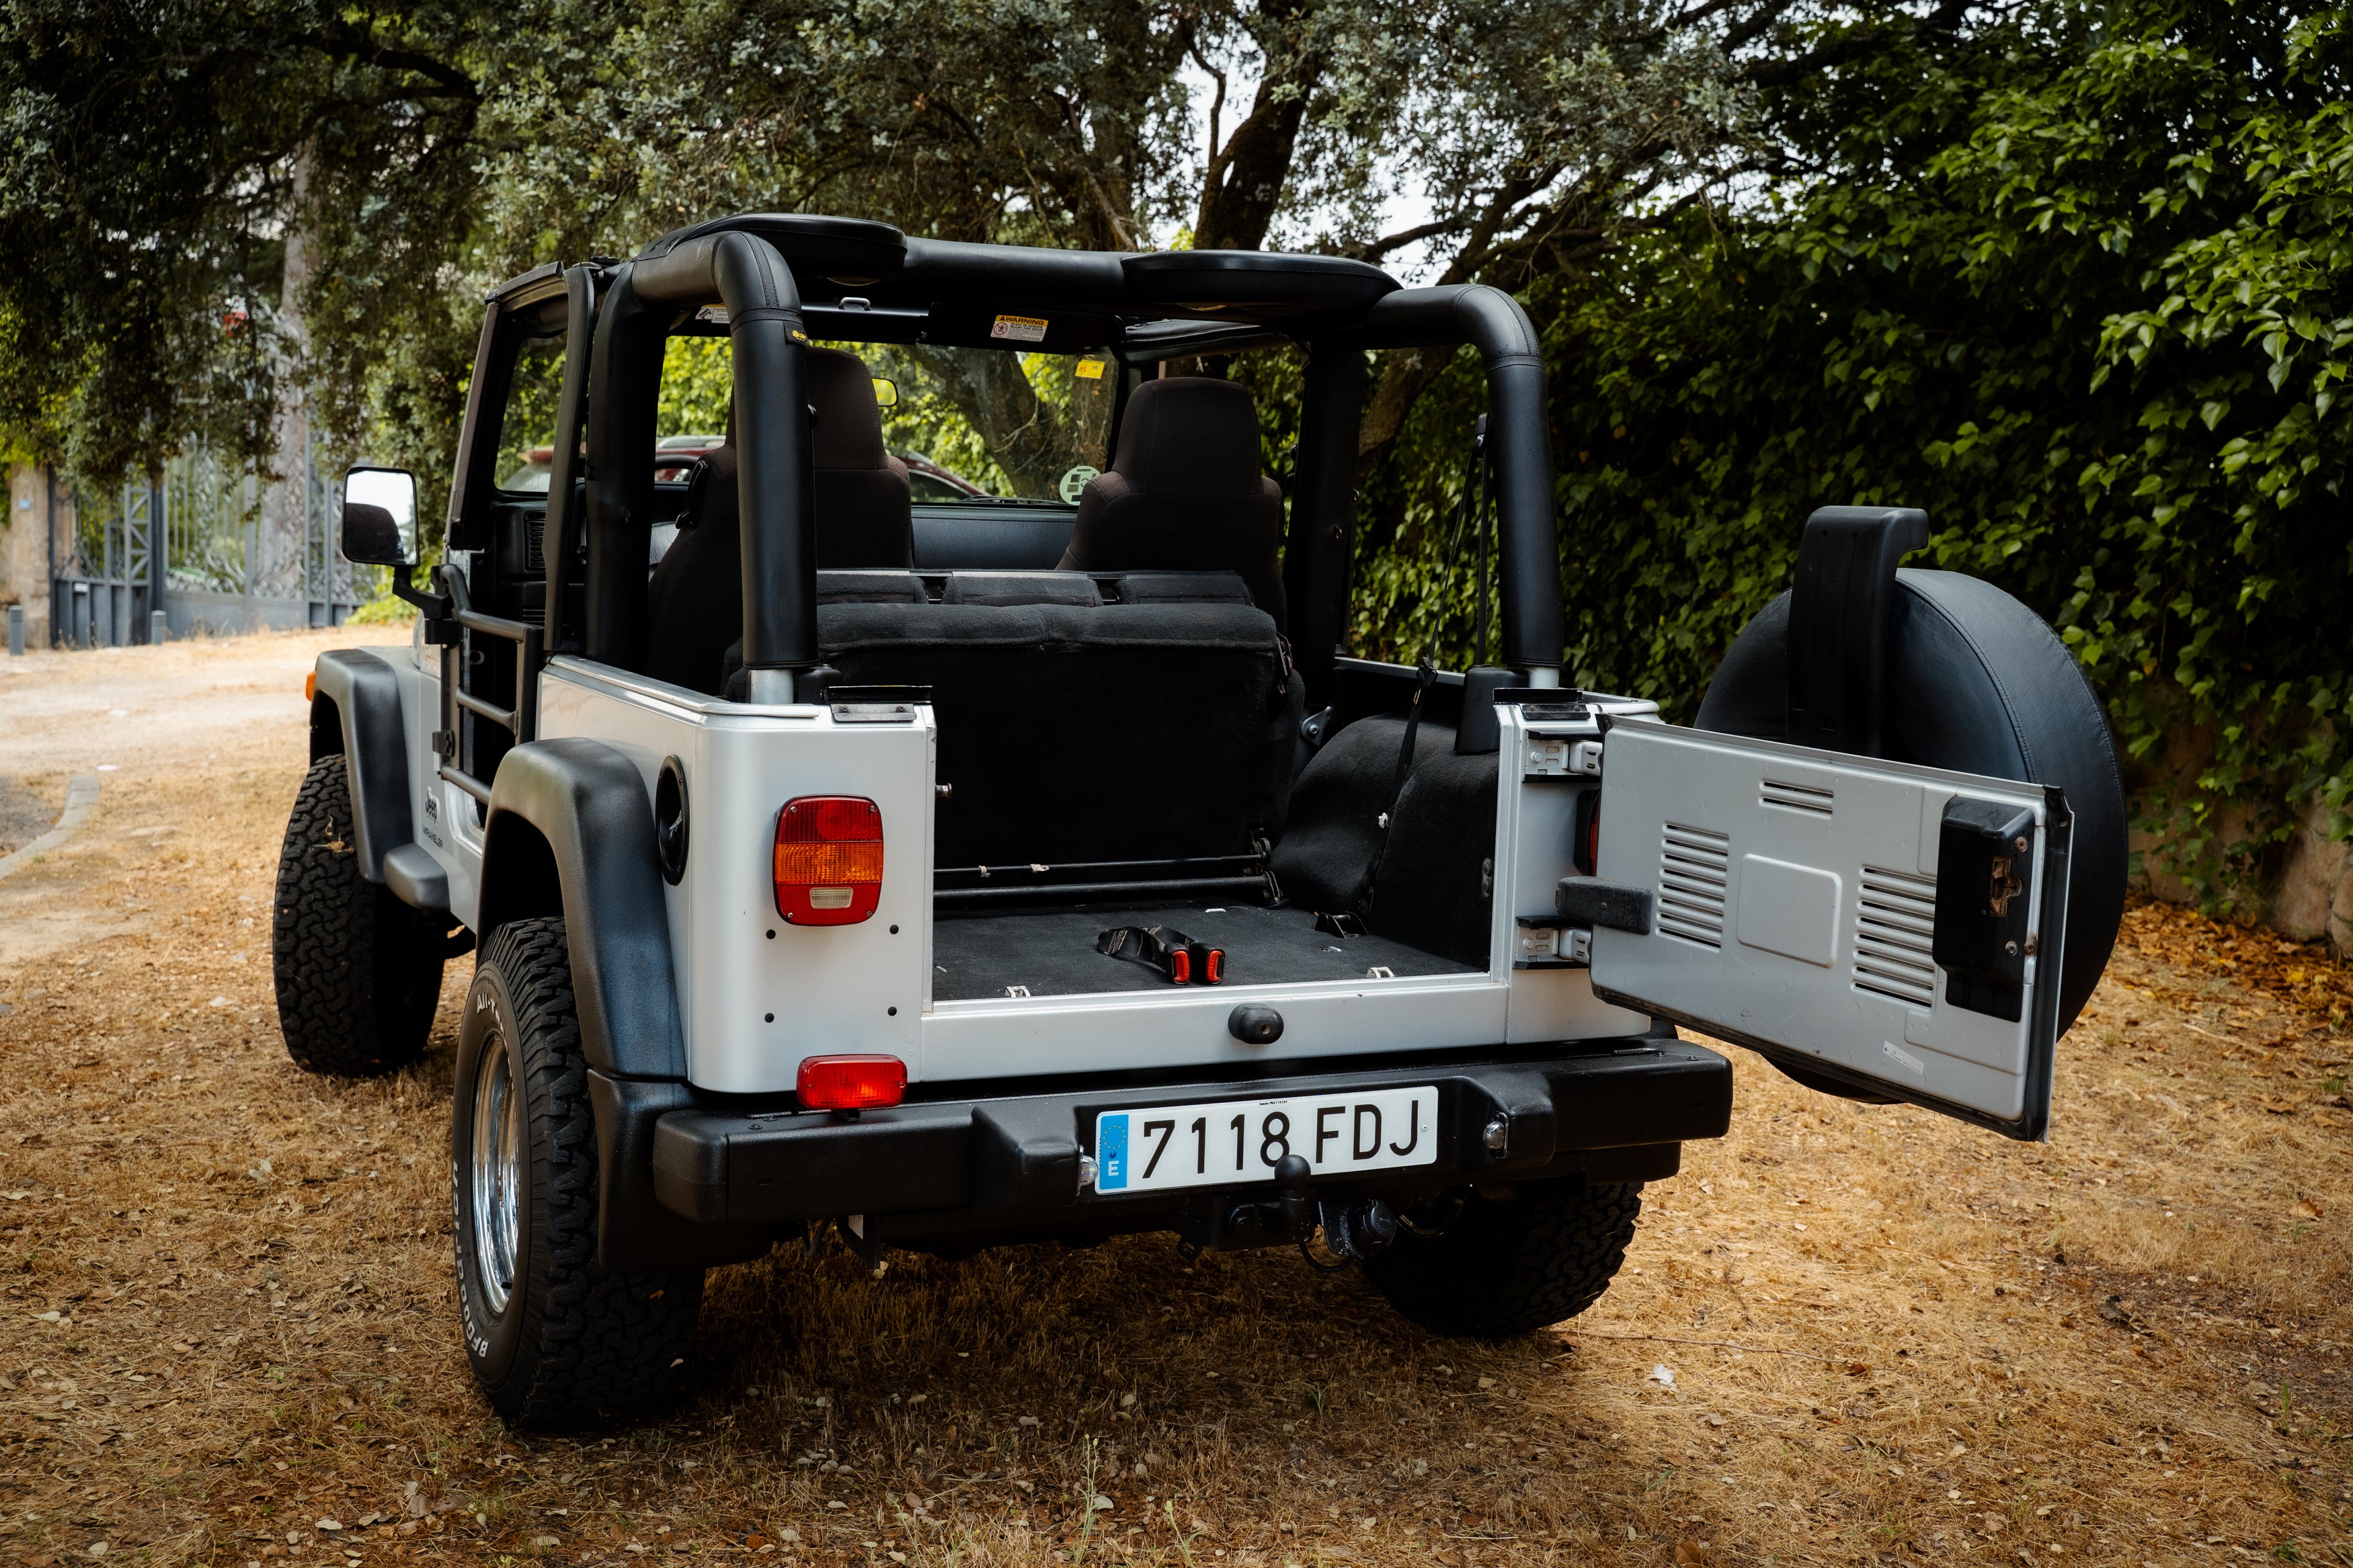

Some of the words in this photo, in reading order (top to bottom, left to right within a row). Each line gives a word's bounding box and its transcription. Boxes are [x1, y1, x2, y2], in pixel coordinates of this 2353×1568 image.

[1006, 316, 1044, 325] WARNING
[425, 786, 440, 828] Jeep
[1142, 1111, 1290, 1179] 7118
[1316, 1100, 1419, 1164] FDJ
[1108, 1160, 1119, 1177] E
[453, 1161, 489, 1358] BFGoodrich
